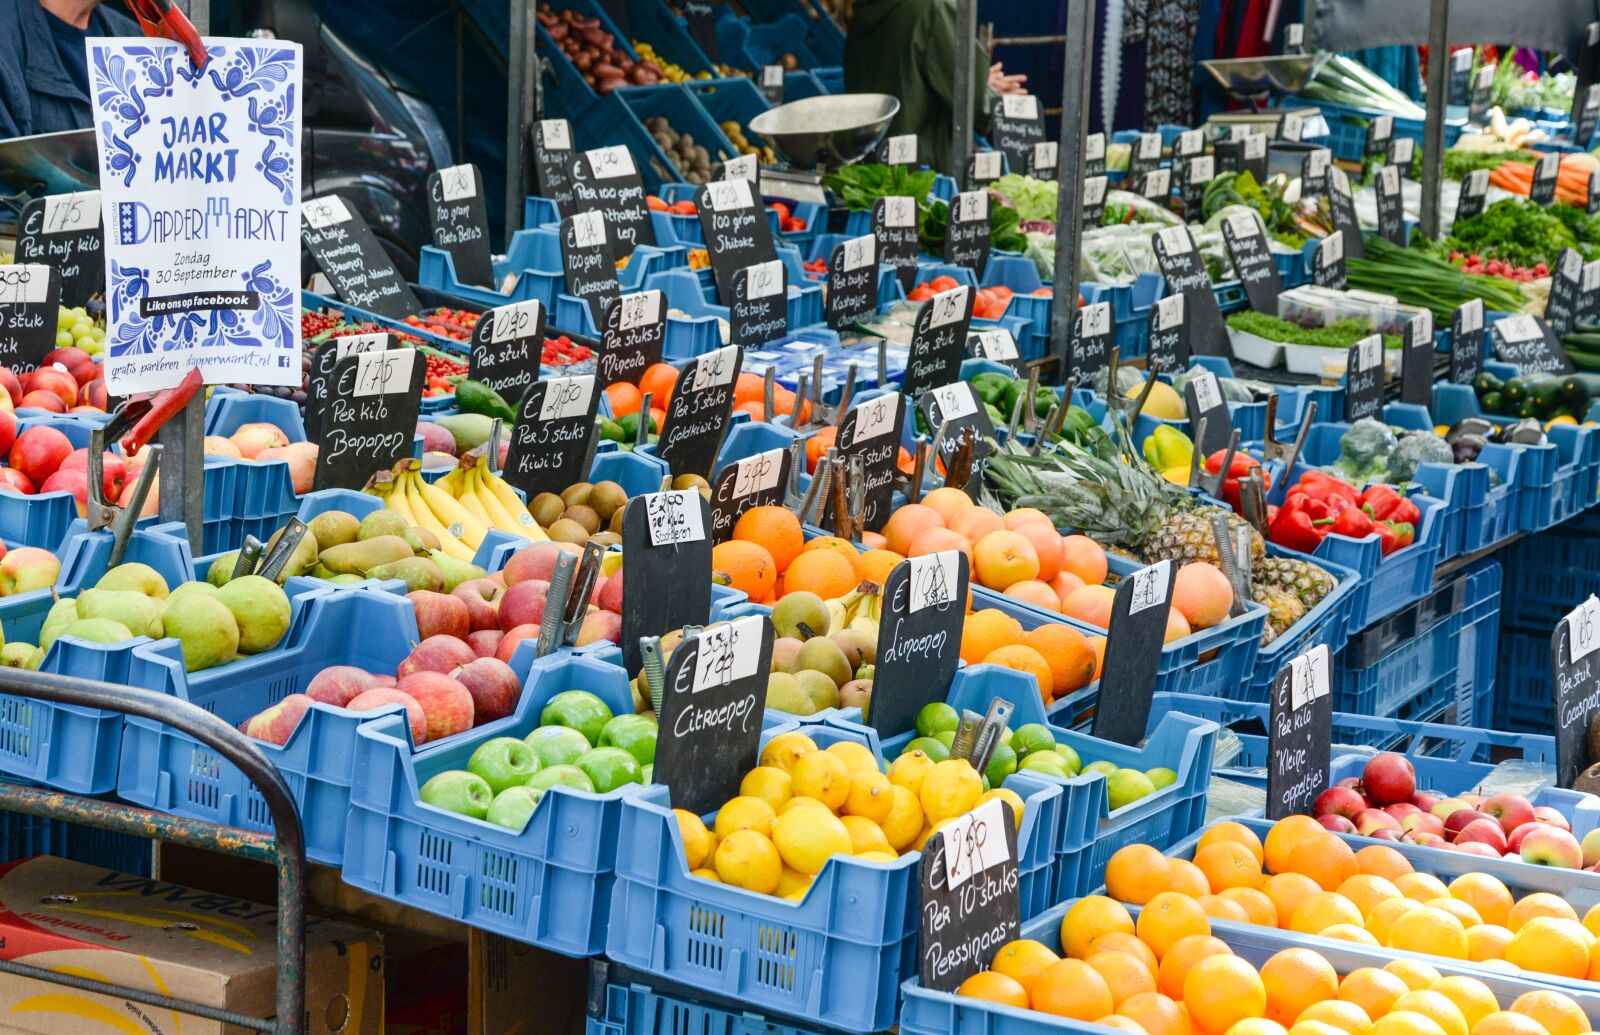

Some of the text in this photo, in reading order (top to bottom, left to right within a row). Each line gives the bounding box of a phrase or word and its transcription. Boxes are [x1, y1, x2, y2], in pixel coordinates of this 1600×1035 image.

[160, 112, 230, 149] JAAR
[155, 148, 239, 184] MARKT
[573, 160, 587, 180] €
[432, 180, 442, 203] €
[573, 182, 598, 200] Per
[599, 187, 617, 199] 100
[617, 186, 643, 205] gram
[701, 190, 712, 208] €
[24, 210, 42, 235] €
[437, 205, 470, 226] 100 gram
[712, 213, 756, 233] 100 gram
[877, 205, 885, 223] €
[952, 202, 960, 224] €
[301, 230, 323, 245] Per
[963, 225, 976, 243] half
[20, 235, 100, 263] Per half kilo
[174, 252, 210, 267] Zondag
[834, 251, 844, 272] €
[569, 253, 603, 273] 100 gram
[156, 267, 237, 285] 30 September
[735, 278, 746, 299] €
[832, 273, 847, 290] Per
[147, 294, 249, 311] Like ons op facebook
[734, 302, 749, 318] Per
[8, 313, 44, 328] stuk
[608, 305, 622, 328] €
[919, 309, 933, 335] €
[480, 319, 494, 343] €
[603, 322, 664, 350] Per stuks 5
[914, 327, 955, 356] Per stuk
[112, 351, 271, 382] gratis parkeren dappermarkt.nl
[320, 348, 336, 374] €
[473, 340, 528, 368] Per stuk
[601, 350, 646, 380] Mineola
[337, 365, 356, 396] €
[681, 368, 696, 395] €
[912, 358, 947, 380] Paprika
[312, 377, 327, 398] Pe
[332, 399, 355, 422] Per
[523, 392, 541, 419] €
[674, 391, 727, 419] Per 5 stuks
[929, 401, 940, 429] €
[517, 421, 584, 445] Per 5 stuks
[840, 420, 855, 450] €
[326, 429, 404, 465] Bananen
[865, 445, 893, 466] stuks
[718, 473, 736, 502] €
[649, 496, 658, 515] €
[711, 508, 732, 530] Per
[892, 578, 909, 613] €
[885, 617, 947, 663] Limoenen
[1558, 632, 1566, 668] €
[675, 650, 697, 694] €
[1557, 663, 1592, 698] Per stuk
[1279, 676, 1289, 707] €
[674, 694, 756, 738] Citroenen
[1276, 711, 1292, 738] Per
[1282, 768, 1323, 811] appeltjes
[929, 846, 946, 890] €
[924, 864, 1018, 935] Per 10 stuks
